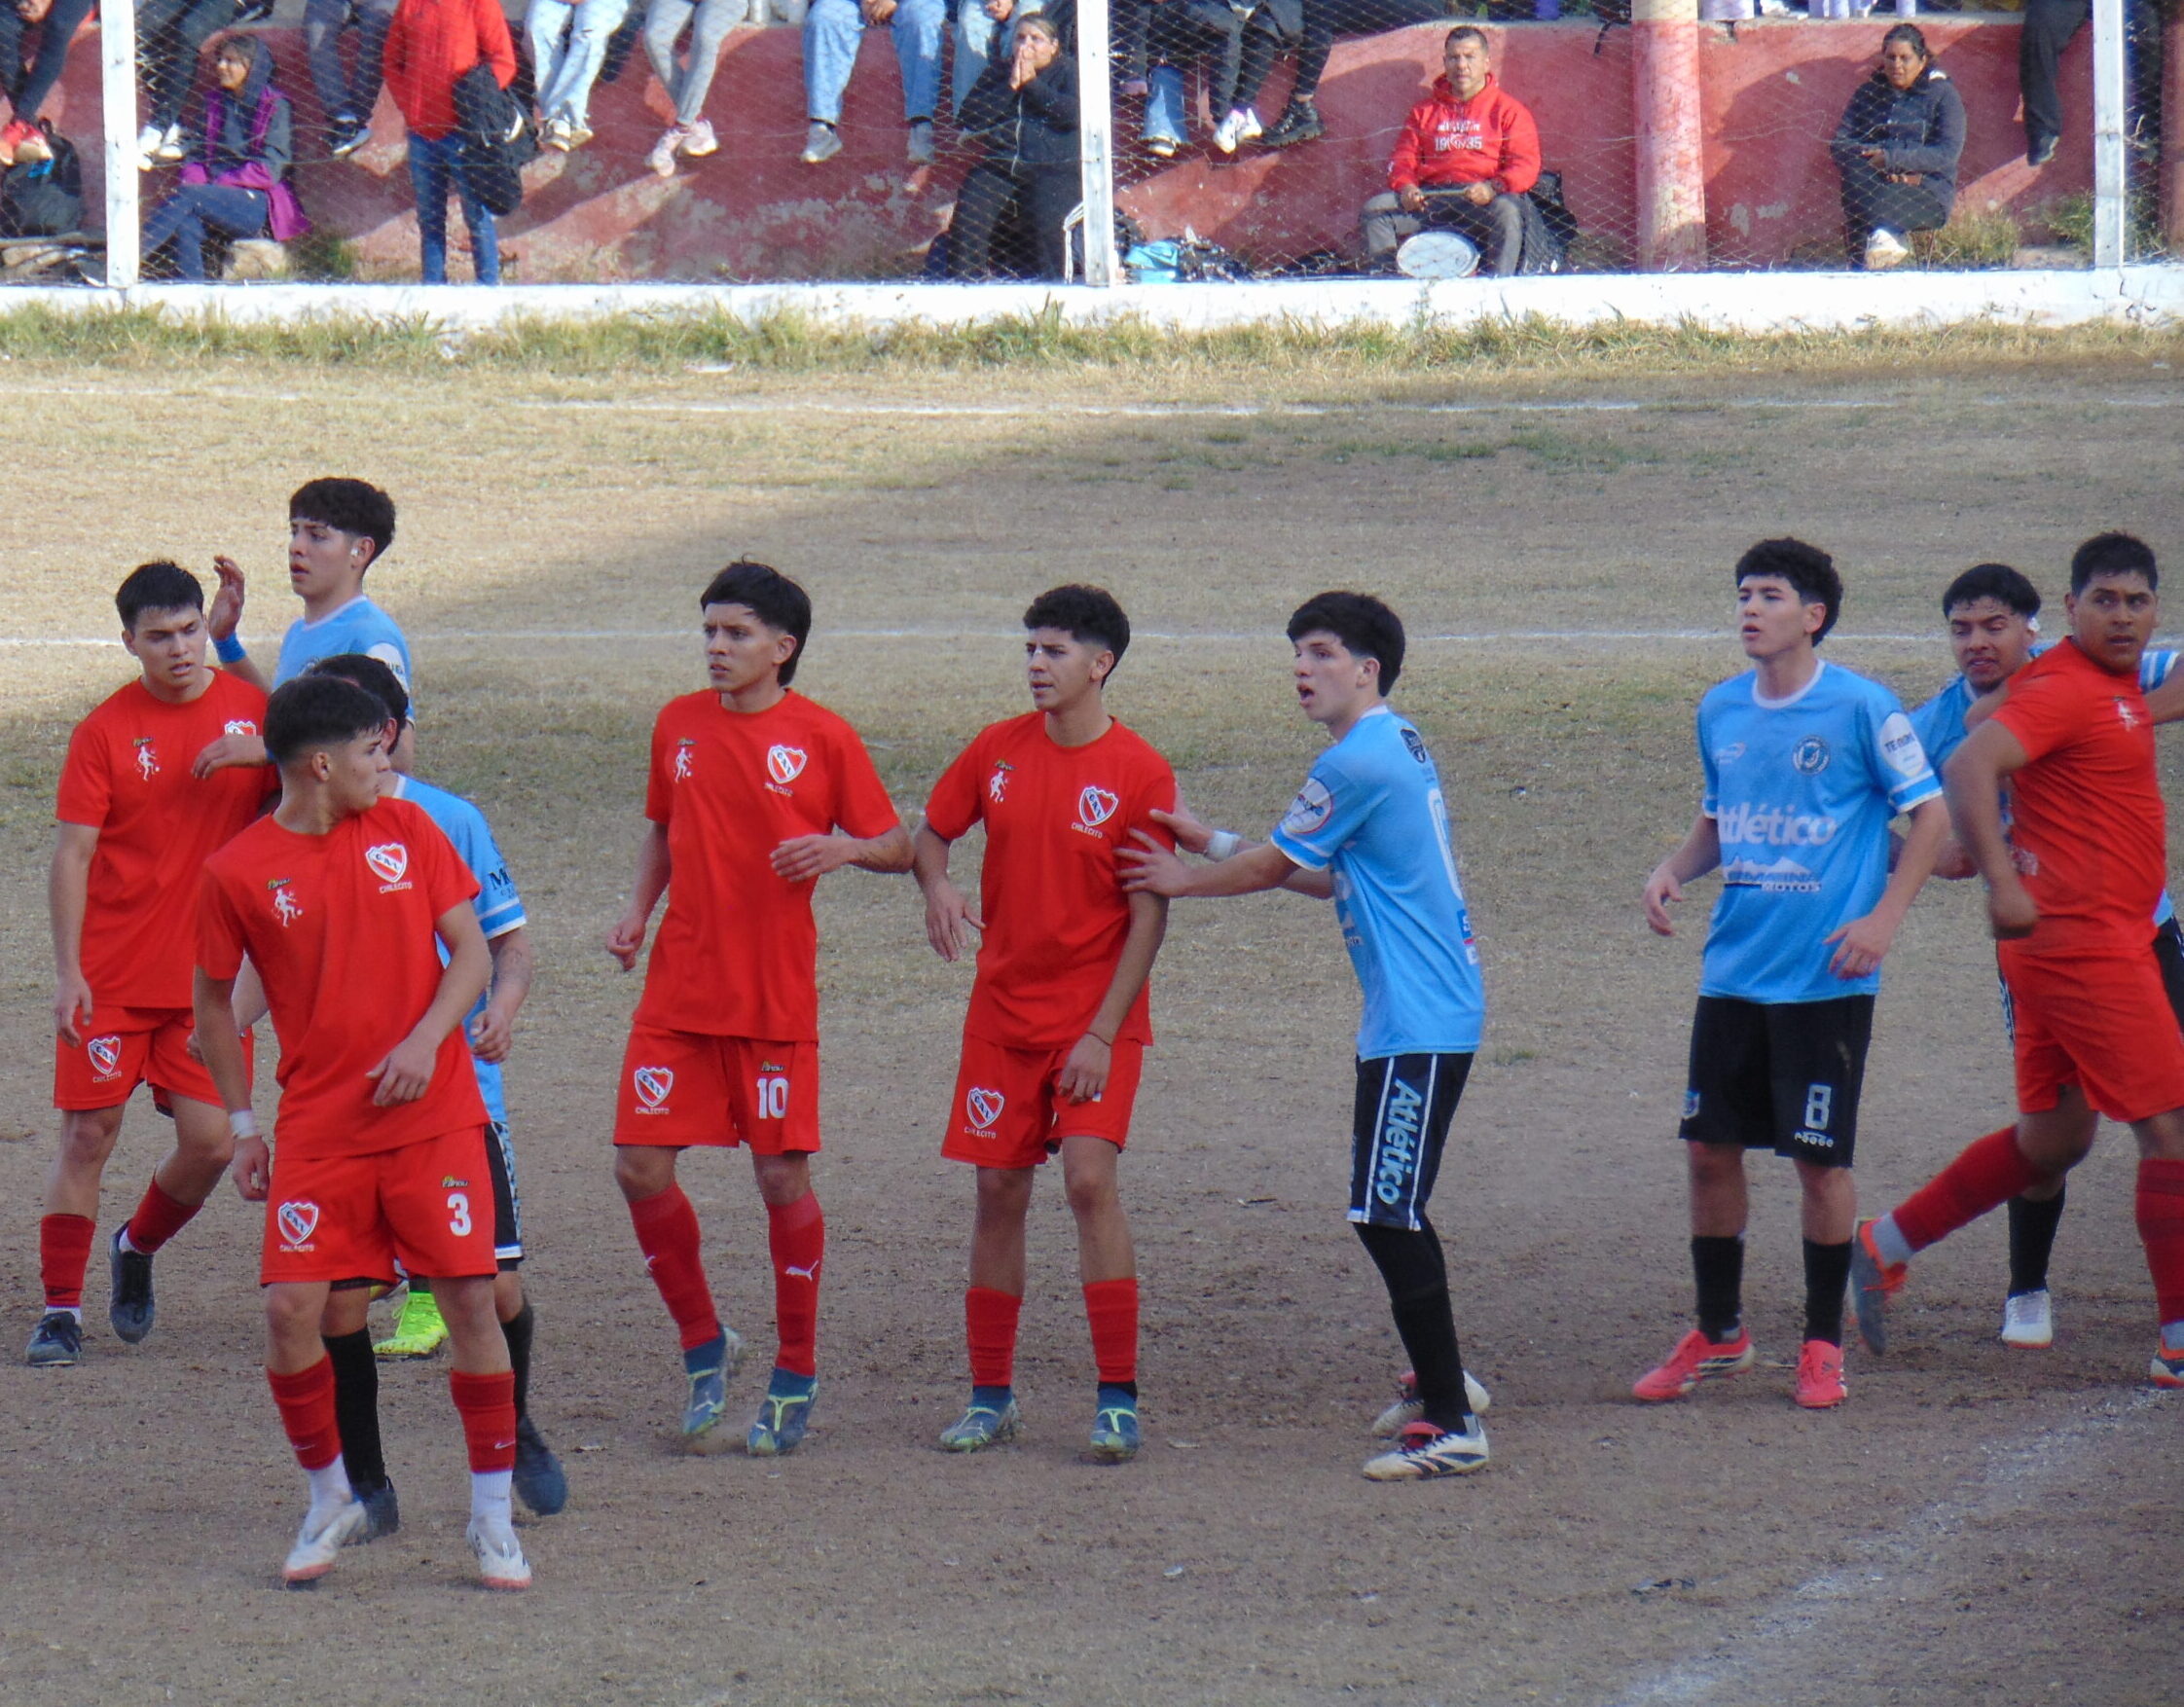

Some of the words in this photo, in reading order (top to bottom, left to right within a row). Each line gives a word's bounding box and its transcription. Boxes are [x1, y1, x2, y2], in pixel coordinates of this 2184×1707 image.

[756, 1077, 788, 1119] 10
[1804, 1084, 1832, 1130] 8
[1376, 1077, 1422, 1205] Atlético
[447, 1193, 472, 1237] 3
